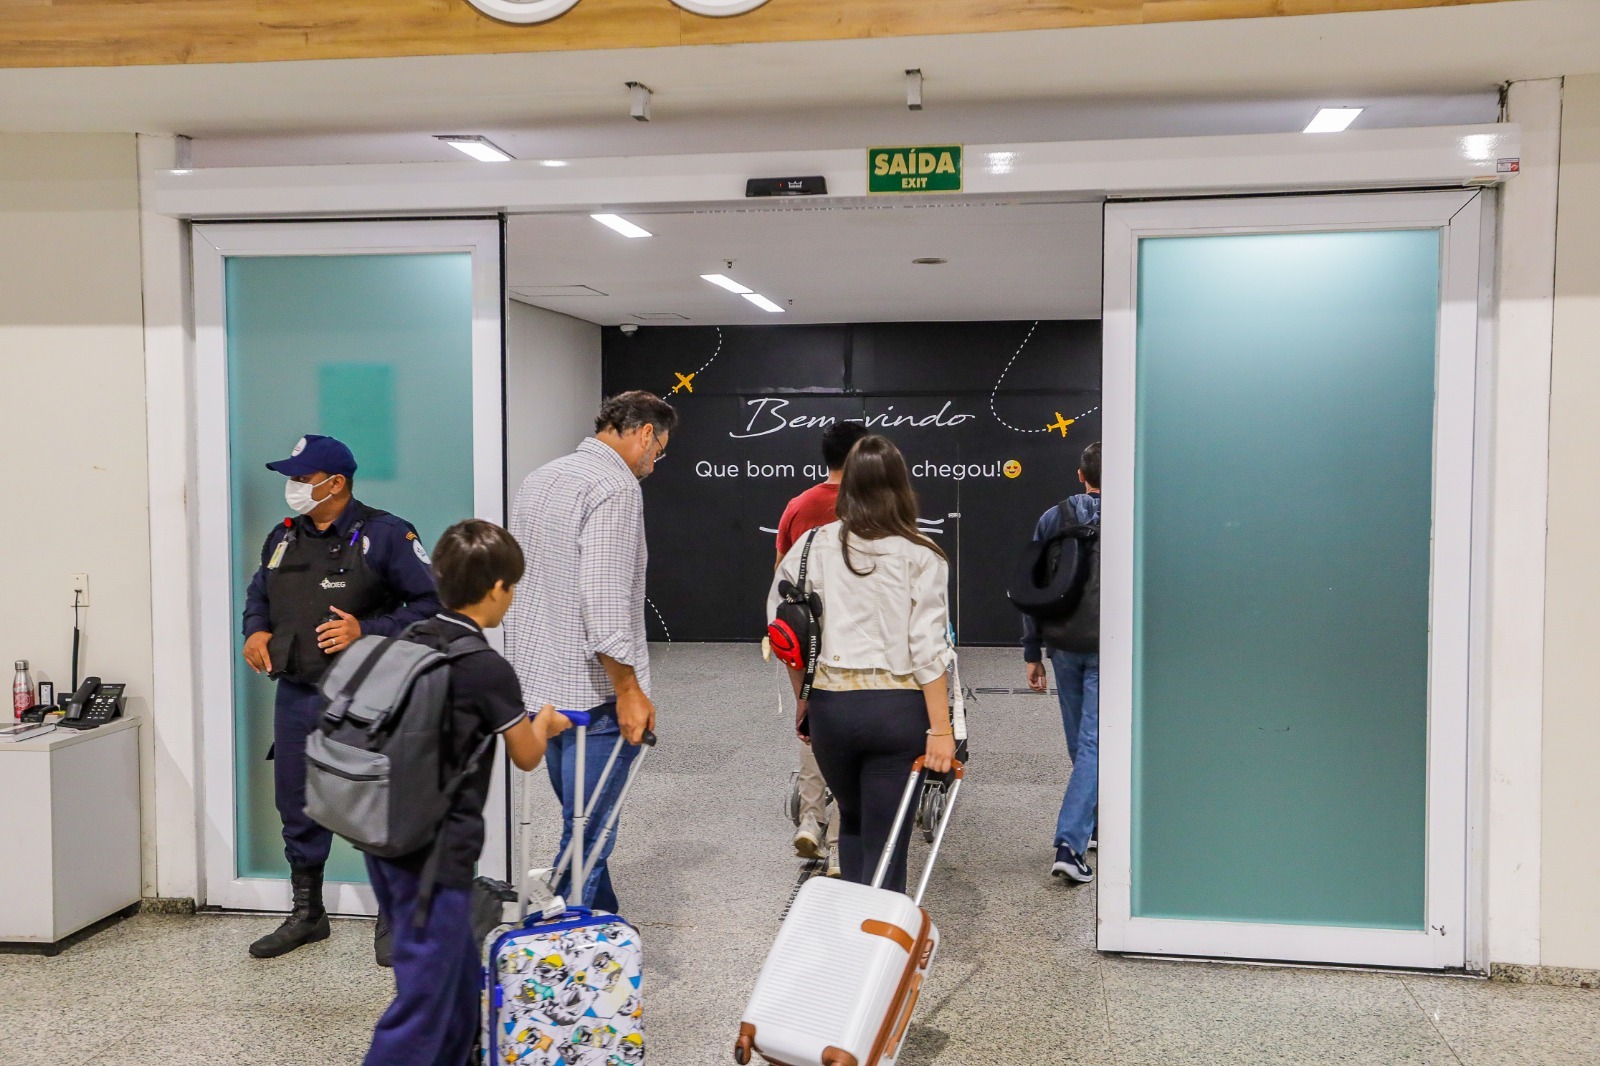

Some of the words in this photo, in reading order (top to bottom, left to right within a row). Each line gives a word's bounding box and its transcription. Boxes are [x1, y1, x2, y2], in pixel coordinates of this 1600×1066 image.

[874, 149, 956, 175] SAÍDA
[901, 177, 928, 189] EXIT
[729, 397, 976, 438] Bem-vindo
[695, 460, 739, 479] Que
[747, 460, 795, 478] bom
[802, 464, 830, 481] qu
[911, 459, 1002, 481] chegou!
